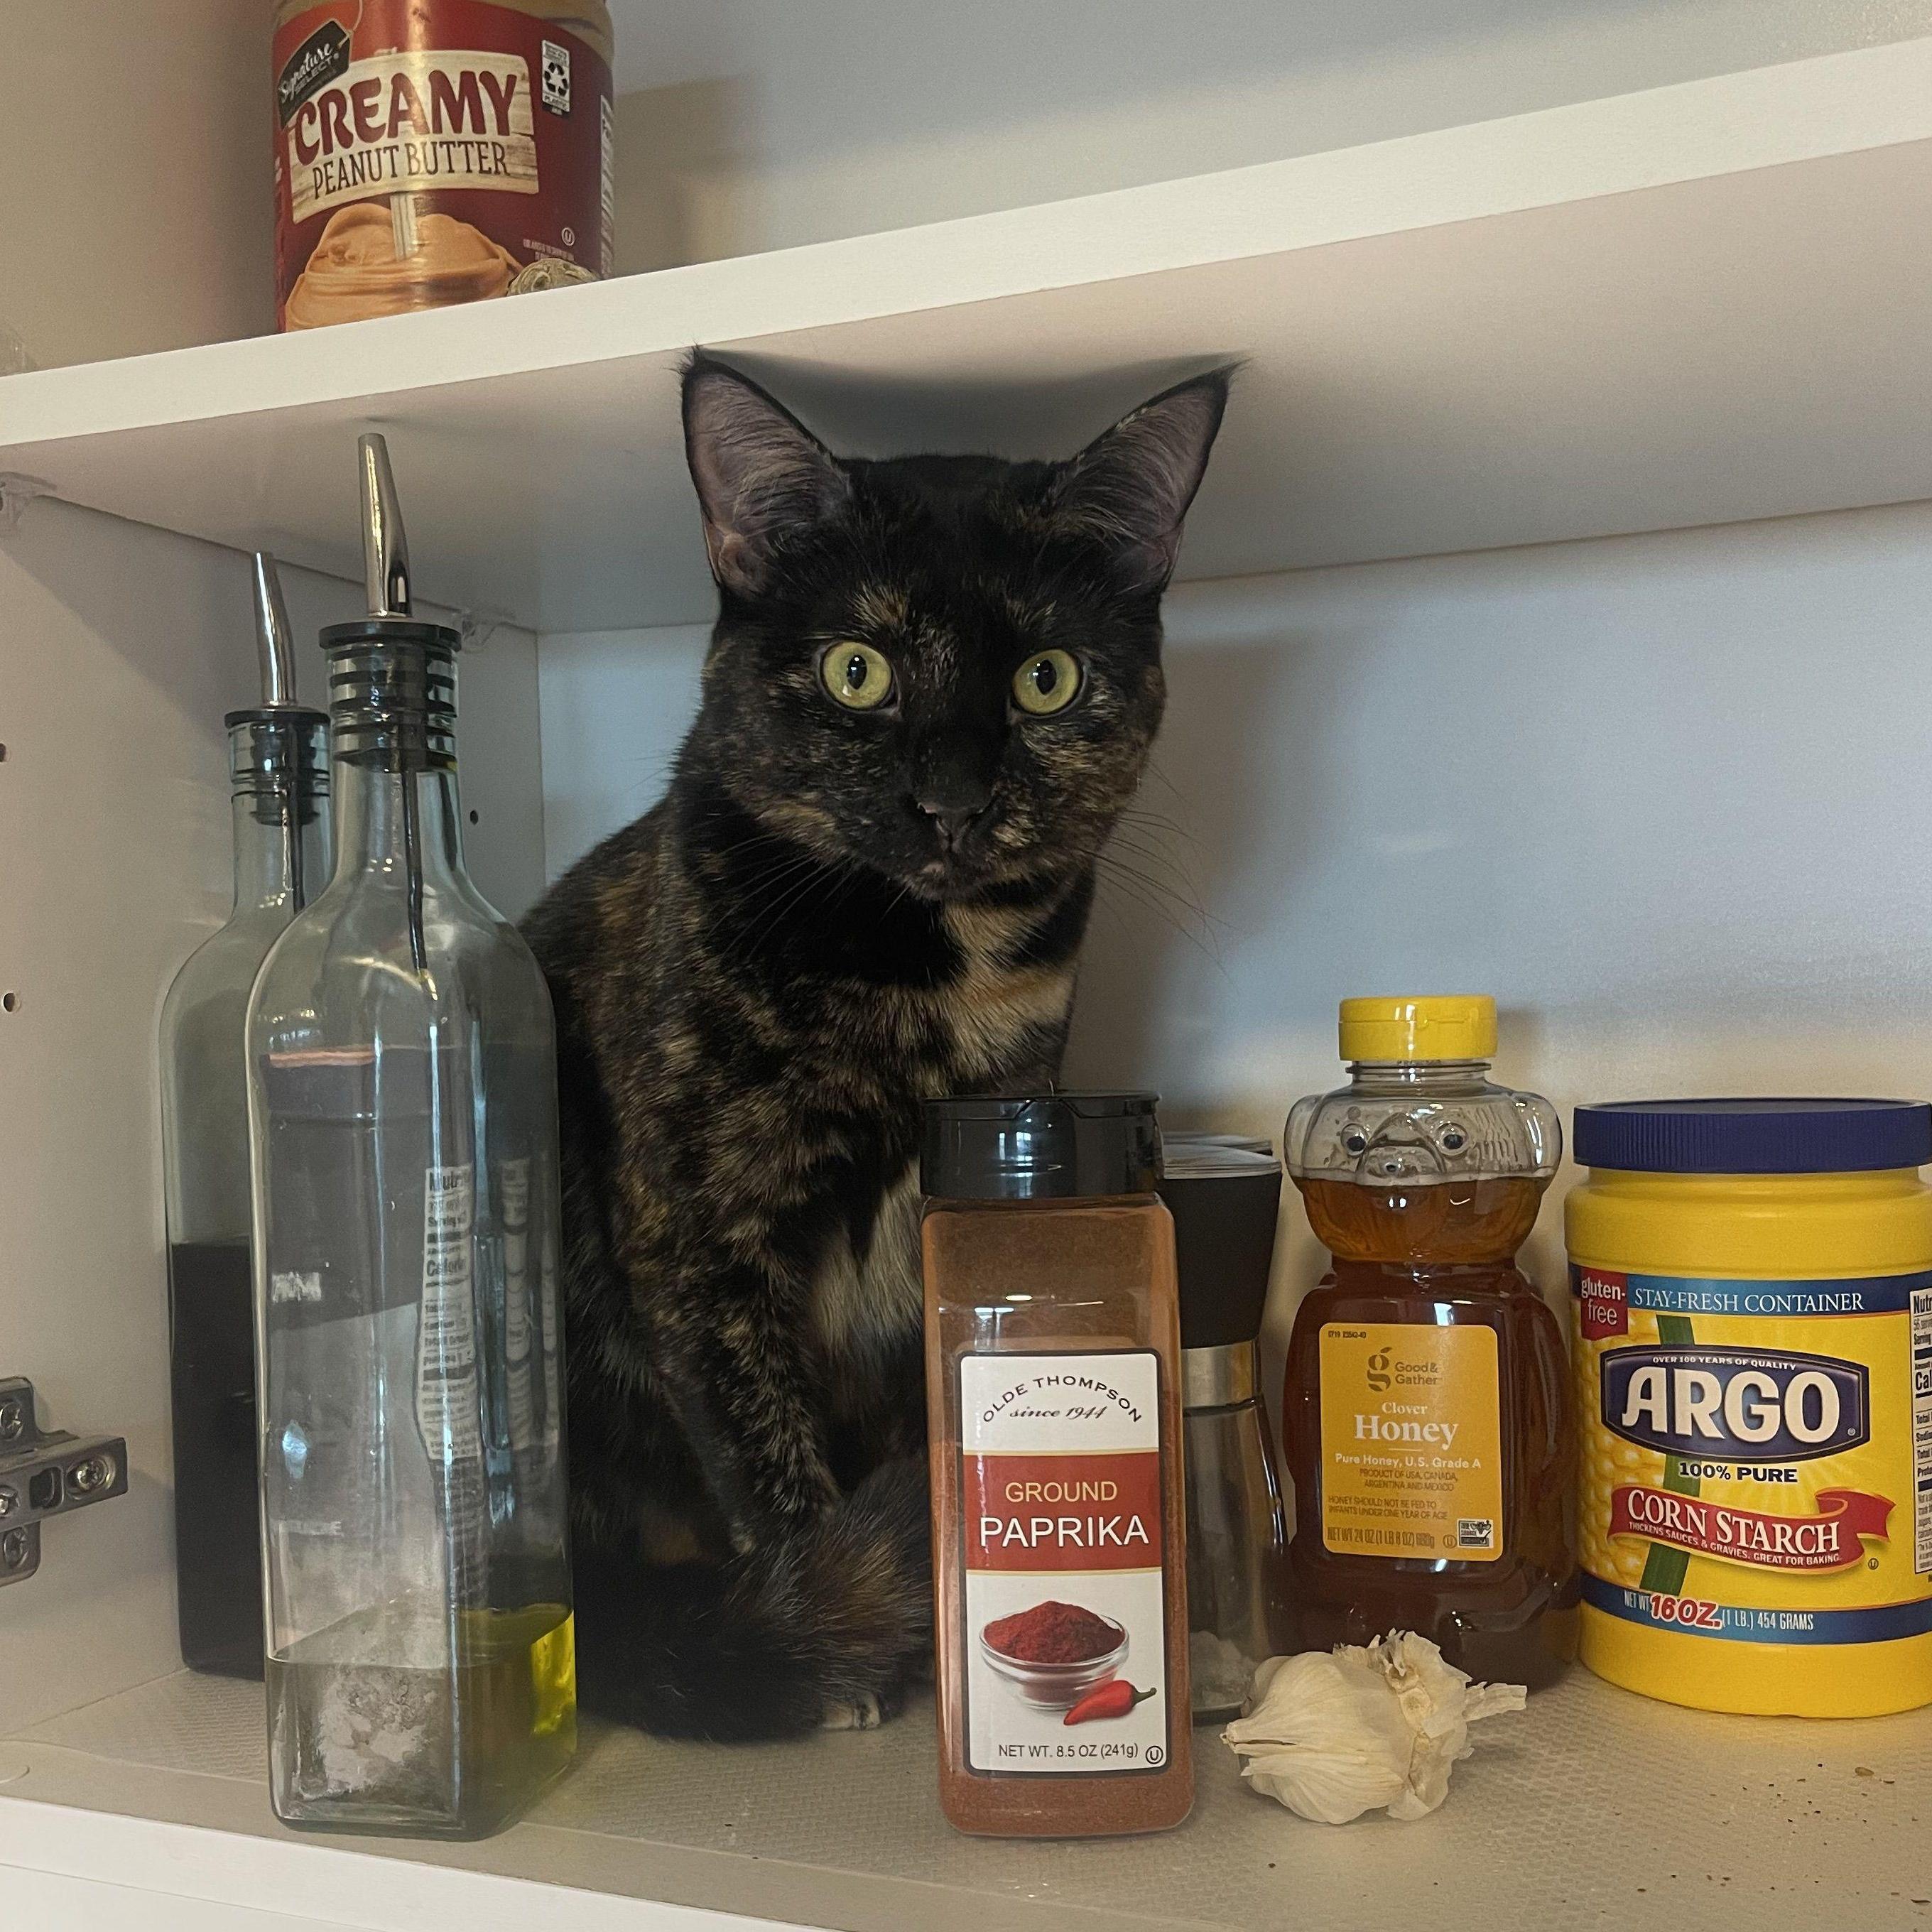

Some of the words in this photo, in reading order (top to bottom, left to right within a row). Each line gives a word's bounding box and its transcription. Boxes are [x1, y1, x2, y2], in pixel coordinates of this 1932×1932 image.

[294, 70, 518, 166] CREAMY
[313, 144, 399, 200] PEANUT
[404, 141, 511, 176] BUTTER
[1581, 1277, 1626, 1301] gluten-
[1634, 1287, 1739, 1313] STAY-FRESH
[1744, 1293, 1864, 1313] CONTAINER
[1588, 1298, 1617, 1325] free
[1679, 1355, 1696, 1364] 100
[1698, 1356, 1733, 1364] YEARS
[1749, 1359, 1797, 1372] QUALITY
[1394, 1374, 1438, 1385] Gather
[983, 1384, 1029, 1423] OLDE
[1032, 1375, 1142, 1423] THOMPSON
[1382, 1401, 1428, 1416] Clover
[1622, 1366, 1840, 1444] ARGO
[1009, 1406, 1060, 1418] since
[1065, 1406, 1108, 1420] 1944
[1354, 1414, 1459, 1450] Honey
[1335, 1453, 1360, 1464] Pure
[1363, 1454, 1403, 1468] Honey,
[1405, 1456, 1429, 1467] U.S.
[1433, 1457, 1470, 1468] Grade
[1472, 1458, 1482, 1469] A
[1679, 1462, 1732, 1480] 100%
[1736, 1466, 1798, 1483] PURE
[1360, 1468, 1393, 1479] PRODUCT
[1364, 1480, 1406, 1489] ARGENTINA
[1005, 1480, 1118, 1503] GROUND
[1328, 1494, 1352, 1505] HONEY
[1353, 1496, 1382, 1507] SHOULD
[1384, 1498, 1399, 1508] NOT
[1426, 1500, 1437, 1509] TO
[1401, 1509, 1419, 1519] YEAR
[1432, 1510, 1448, 1520] AGE
[1627, 1489, 1708, 1538] CORN
[1716, 1511, 1840, 1554] STARCH
[980, 1514, 1150, 1548] PAPRIKA
[1355, 1528, 1363, 1543] 24
[1384, 1530, 1394, 1545] LB
[1629, 1521, 1664, 1537] THICKENS
[1665, 1529, 1698, 1547] SAUCES
[1701, 1539, 1708, 1549] &
[1753, 1552, 1783, 1565] GREAT
[1785, 1556, 1803, 1566] FOR
[1624, 1590, 1637, 1609] NET
[1735, 1609, 1754, 1631] LB.)
[1757, 1612, 1776, 1629] 454
[1779, 1612, 1814, 1630] GRAMS
[999, 1744, 1025, 1757] NET
[1028, 1745, 1053, 1757] WT.
[1056, 1744, 1075, 1757] 8.5
[1078, 1744, 1098, 1757] OZ
[1100, 1743, 1139, 1760] (241g)
